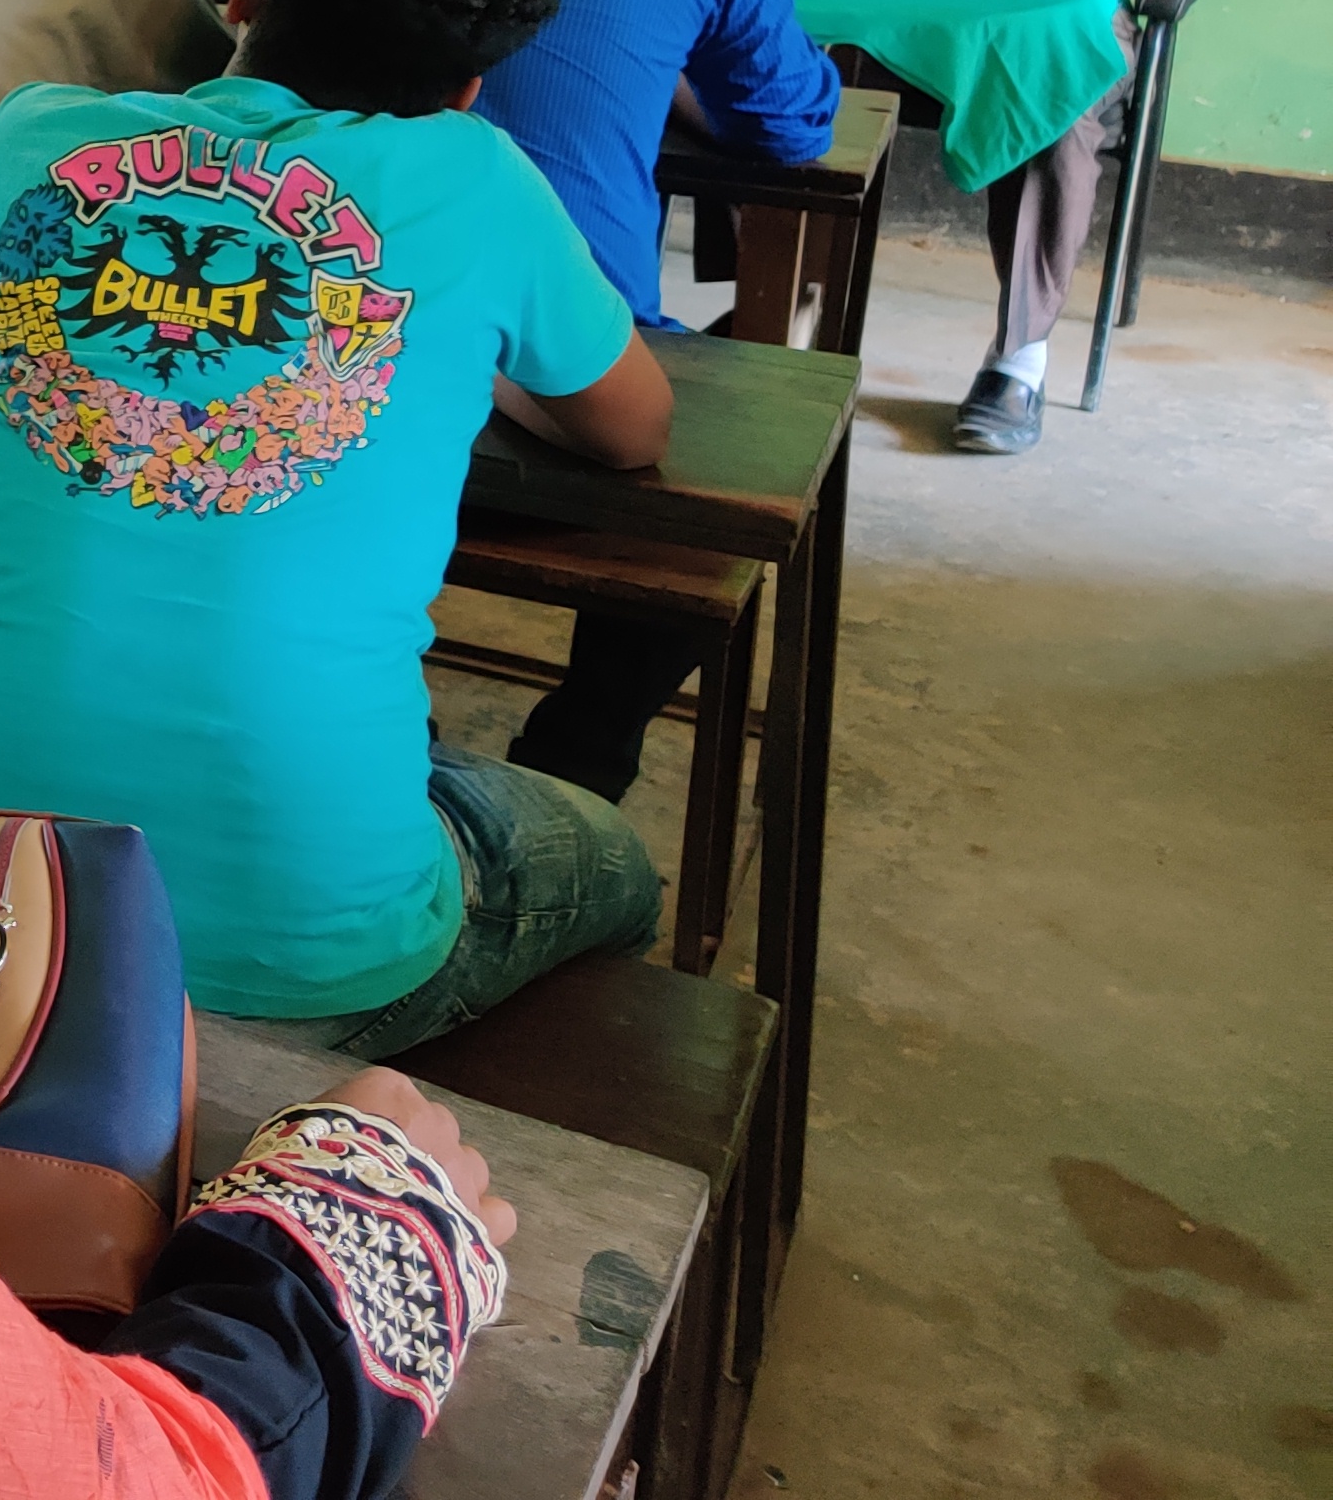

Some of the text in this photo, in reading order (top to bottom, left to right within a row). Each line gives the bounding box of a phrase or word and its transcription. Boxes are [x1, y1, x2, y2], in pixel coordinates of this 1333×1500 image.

[49, 125, 383, 272] BULLET
[34, 276, 64, 350] SPEED
[92, 258, 267, 336] BULLET
[147, 311, 208, 330] WHEELS
